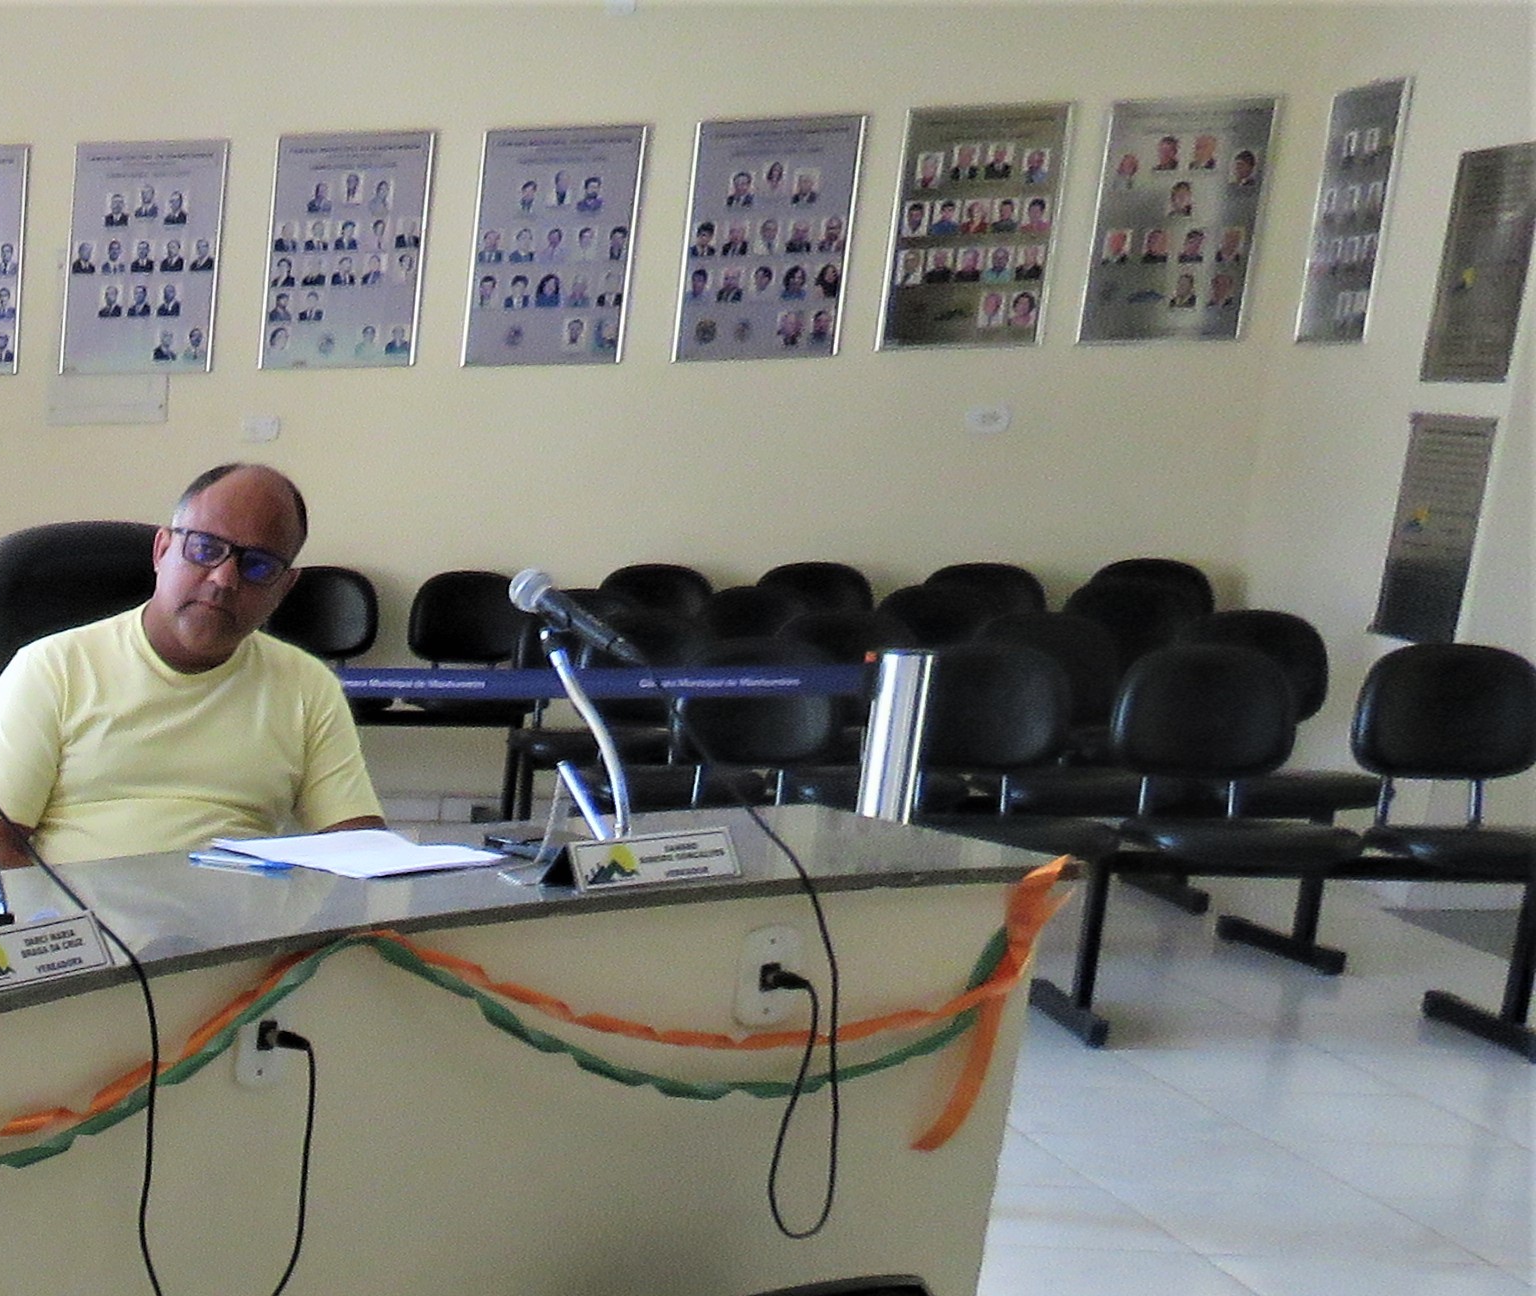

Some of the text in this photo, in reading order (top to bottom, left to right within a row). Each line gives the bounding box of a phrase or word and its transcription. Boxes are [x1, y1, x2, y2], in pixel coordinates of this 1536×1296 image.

[49, 929, 75, 941] MARIA
[21, 937, 84, 959] BRAGA DA CRUZ
[36, 956, 83, 974] VEREADORA
